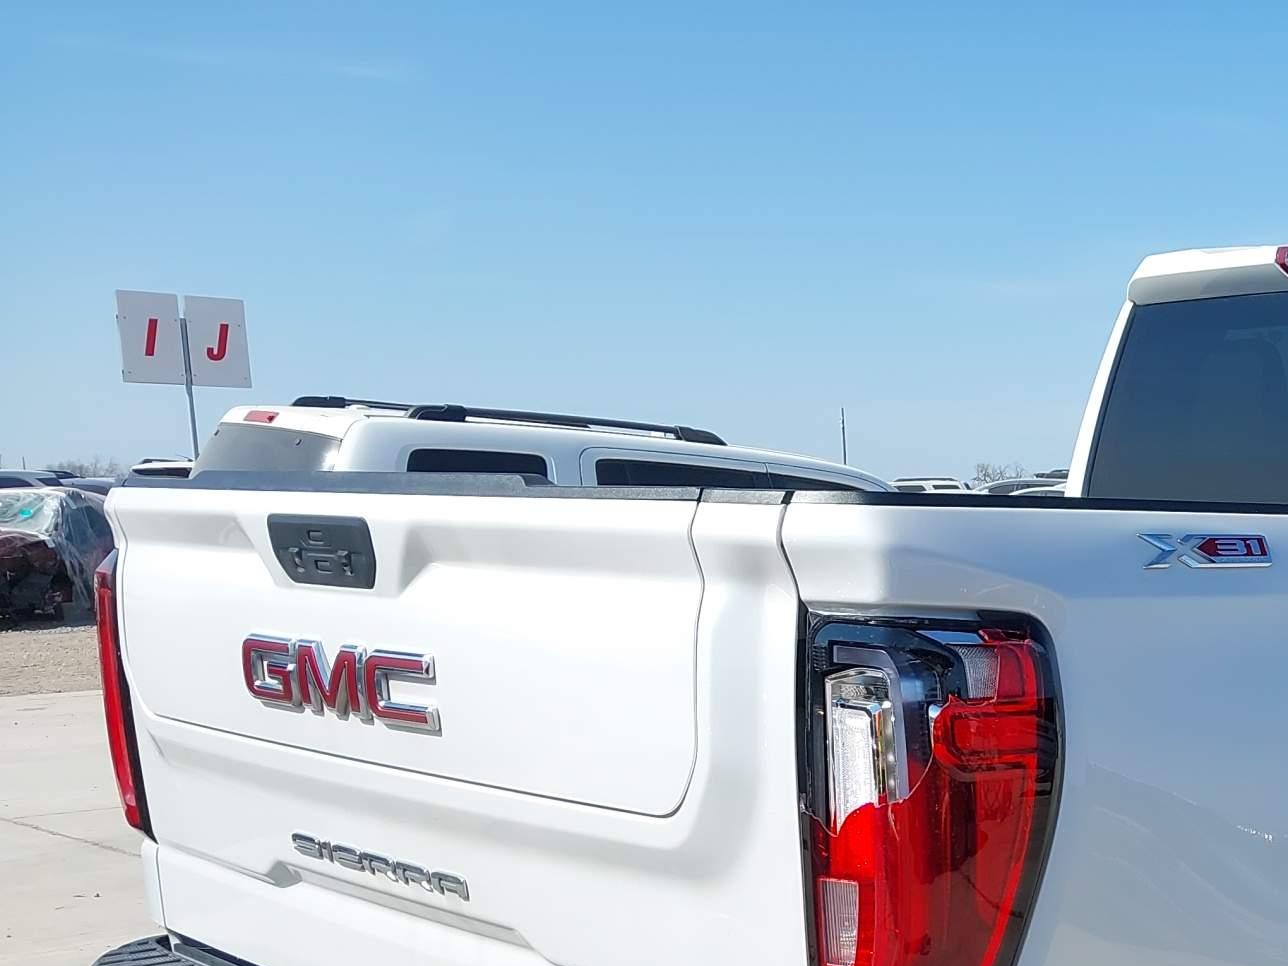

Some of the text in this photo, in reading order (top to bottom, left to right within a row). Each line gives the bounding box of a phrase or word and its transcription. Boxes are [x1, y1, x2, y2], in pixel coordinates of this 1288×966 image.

[145, 318, 159, 357] I
[206, 323, 229, 362] J
[1135, 533, 1273, 569] X31
[241, 633, 443, 738] GMC
[291, 831, 471, 903] SIERRA
